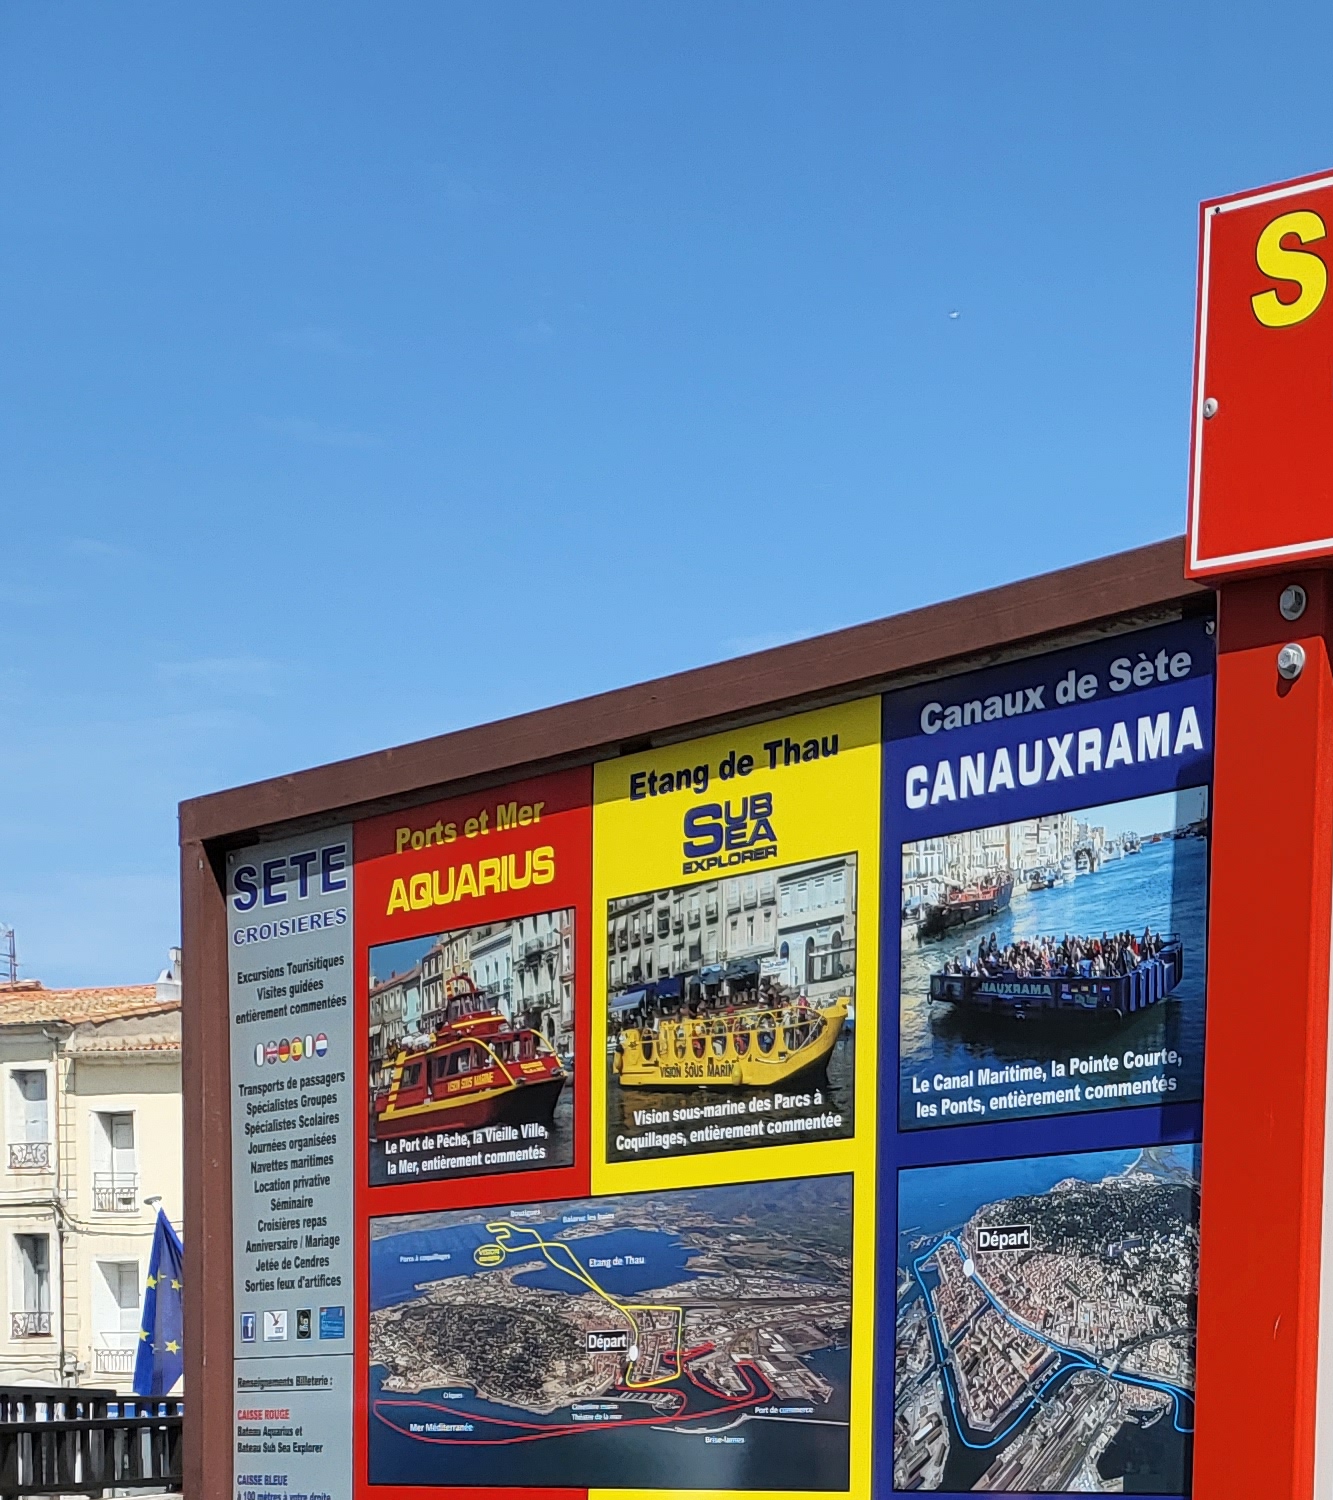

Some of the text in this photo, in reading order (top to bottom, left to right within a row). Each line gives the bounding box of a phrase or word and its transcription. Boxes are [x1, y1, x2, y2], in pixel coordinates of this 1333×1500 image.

[920, 648, 1192, 735] Canaux de Sète
[629, 730, 840, 801] Etang de Thau
[905, 706, 1203, 809] CANAUXRAMA
[396, 801, 545, 855] Ports et Mer
[683, 845, 777, 875] EXPLORER
[233, 842, 347, 912] SETE
[386, 845, 555, 916] AQUARIUS
[233, 907, 347, 946] CROISIERES
[237, 963, 284, 985] Excursions
[257, 977, 323, 1001] Visites guidées
[236, 994, 347, 1025] entièrement commentées
[239, 1070, 345, 1098] Transports de passagers
[912, 1045, 1182, 1094] Le Canal Maritime, la Pointe Courte,
[246, 1092, 338, 1116] Spécialistes Groupes
[633, 1089, 822, 1126] Vision sous-marine des Parcs à
[916, 1074, 1178, 1118] les Ponts, entièrement commentés
[385, 1122, 549, 1155] Le Port de Pêche, la Vieille Ville,
[616, 1112, 842, 1152] Coquillages, entièrement commentée
[387, 1144, 546, 1176] la Mer, entièrement commentés
[254, 1175, 330, 1193] Location privative
[271, 1196, 313, 1211] Séminaire
[979, 1229, 1029, 1248] Départ
[245, 1275, 341, 1292] Sorties feux d'artifices
[589, 1333, 627, 1350] Départ
